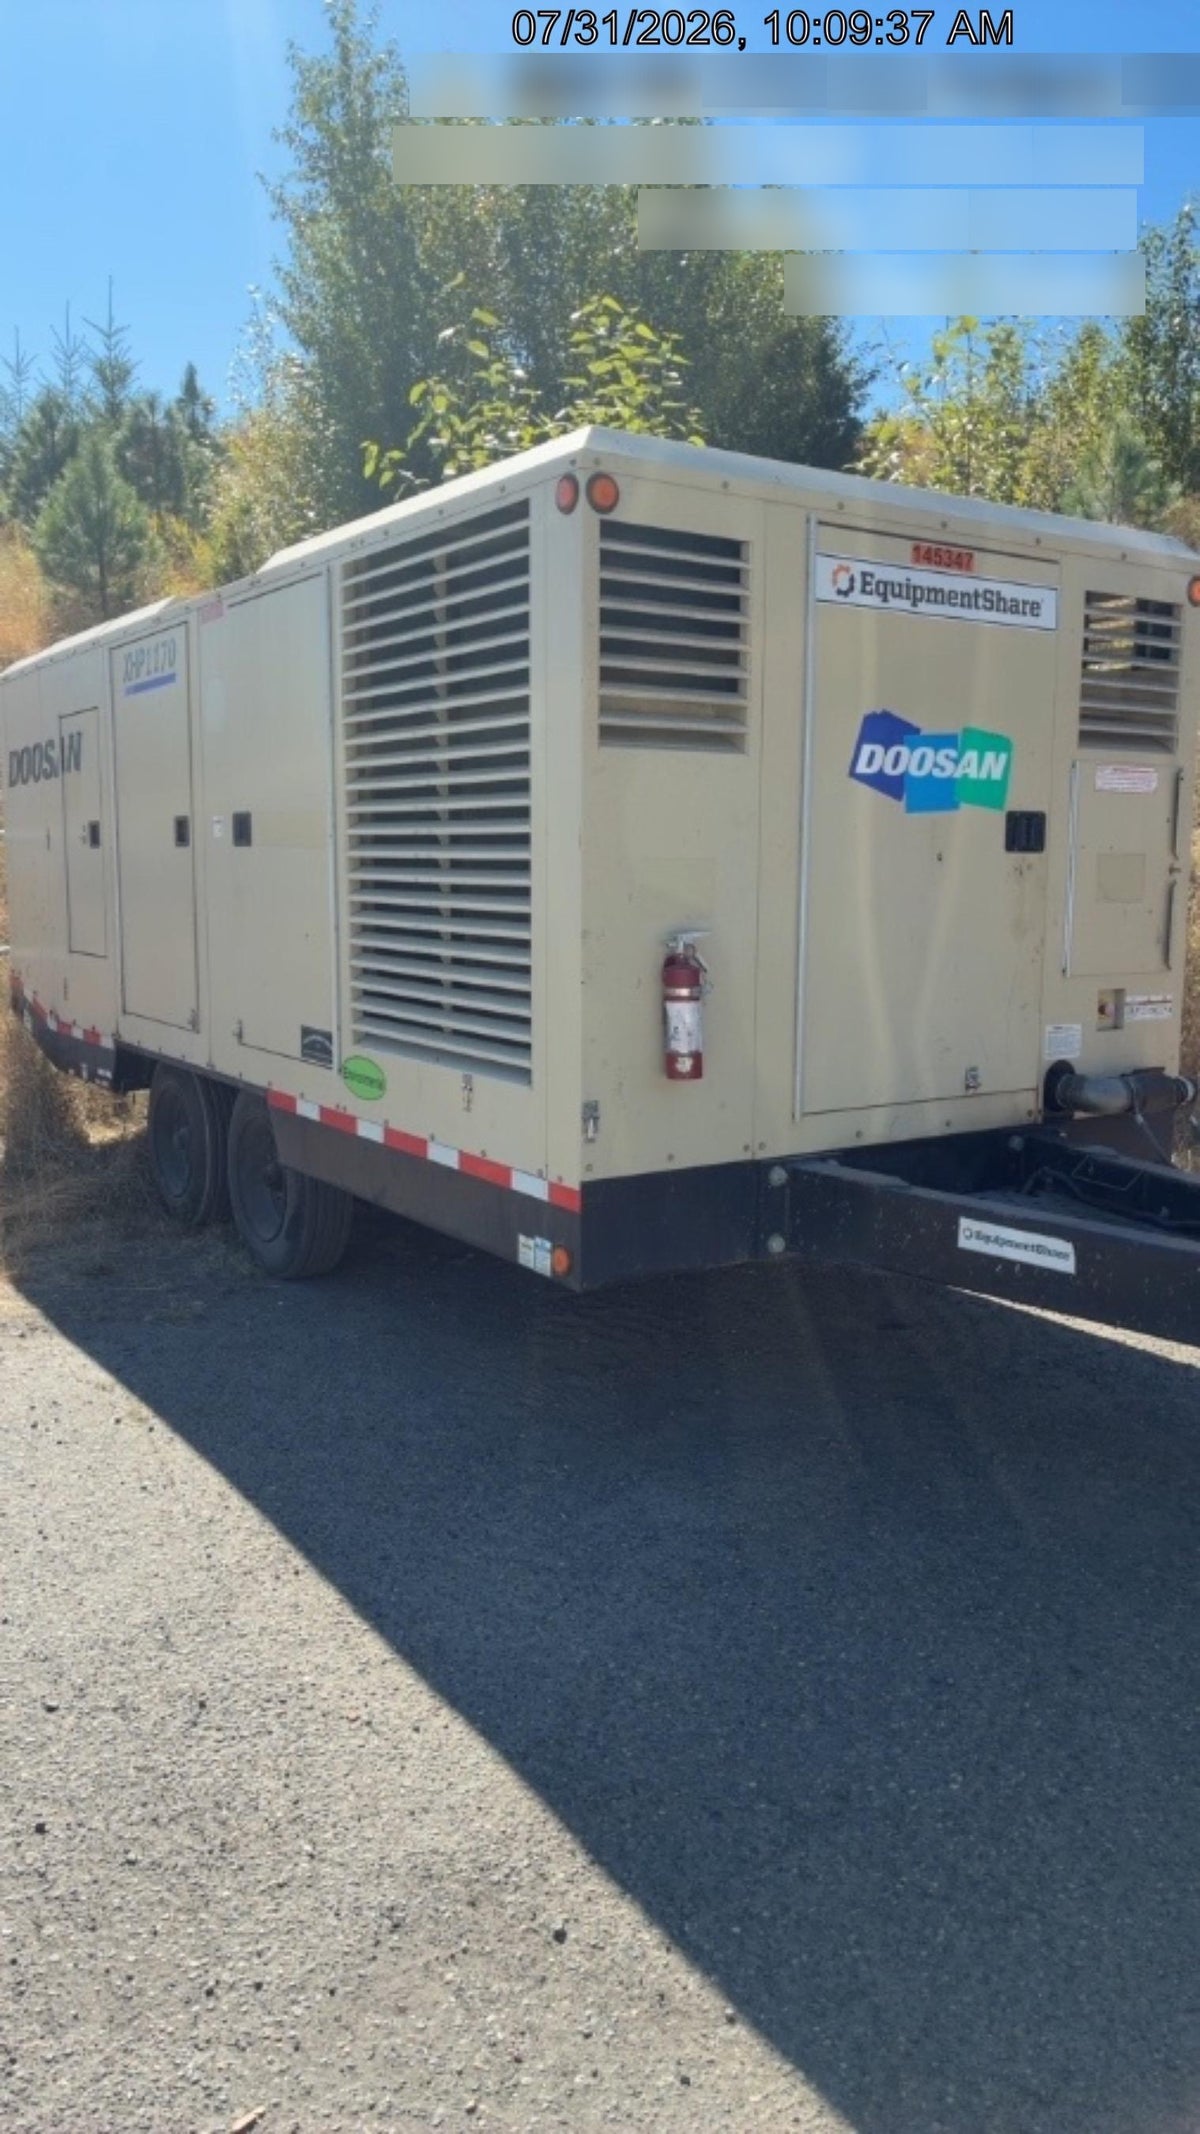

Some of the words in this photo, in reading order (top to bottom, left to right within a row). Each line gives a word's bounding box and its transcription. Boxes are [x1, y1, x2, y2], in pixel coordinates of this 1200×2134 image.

[912, 544, 975, 571] 145347
[859, 571, 1041, 617] EquipmentShare
[9, 731, 82, 788] DOOSAN
[855, 743, 1008, 780] DOOSAN
